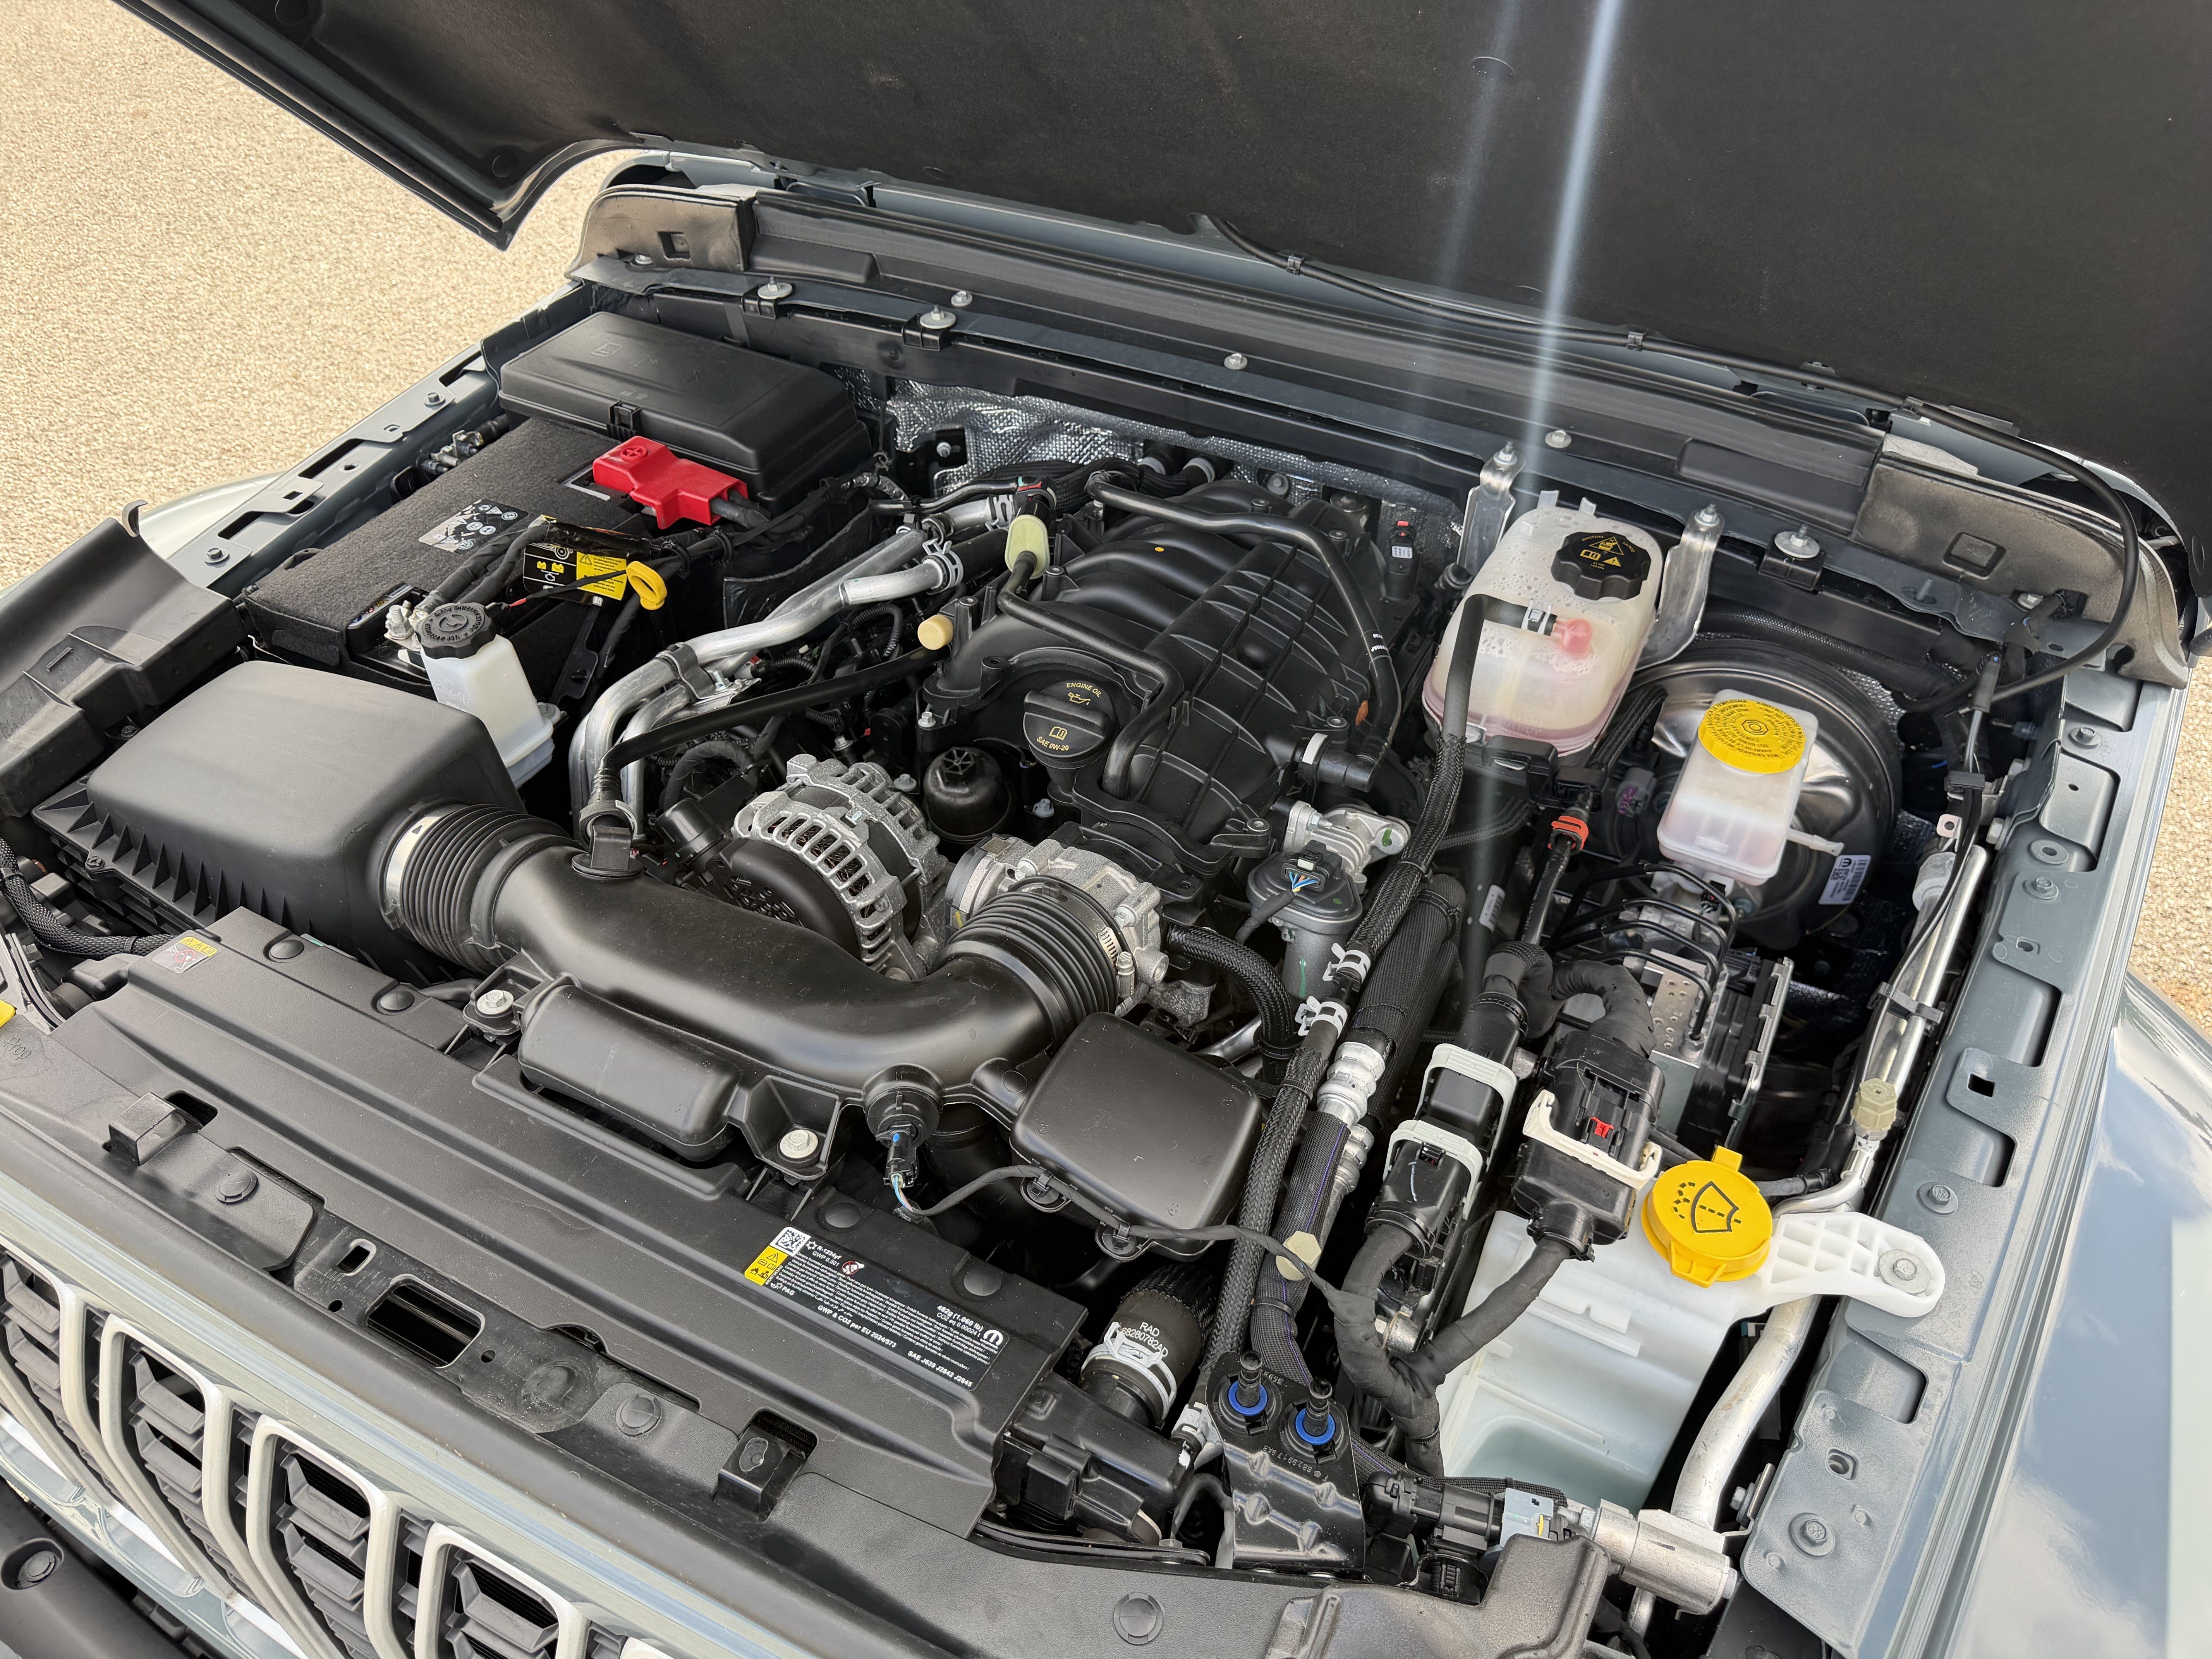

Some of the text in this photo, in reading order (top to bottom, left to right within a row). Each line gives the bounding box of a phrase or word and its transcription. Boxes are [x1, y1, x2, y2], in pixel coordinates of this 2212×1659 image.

[1066, 682, 1102, 698] ENGINE OIL
[1036, 736, 1050, 747] SAE
[811, 1250, 840, 1267] GWP 0.501
[815, 1245, 842, 1261] R-1234yf
[781, 1286, 796, 1296] PAG
[816, 1304, 833, 1316] GWP
[837, 1314, 852, 1325] CO2
[849, 1322, 862, 1331] per
[860, 1326, 872, 1335] EU
[869, 1331, 898, 1348] 2024/573
[935, 1304, 984, 1332] 482g (1.060 lb)
[936, 1312, 950, 1321] CO2
[955, 1322, 978, 1336] 0.00024
[1139, 1322, 1160, 1337] RAD
[1121, 1327, 1168, 1357] 68280782AD
[907, 1350, 974, 1388] SAE J639 J2842 J2845
